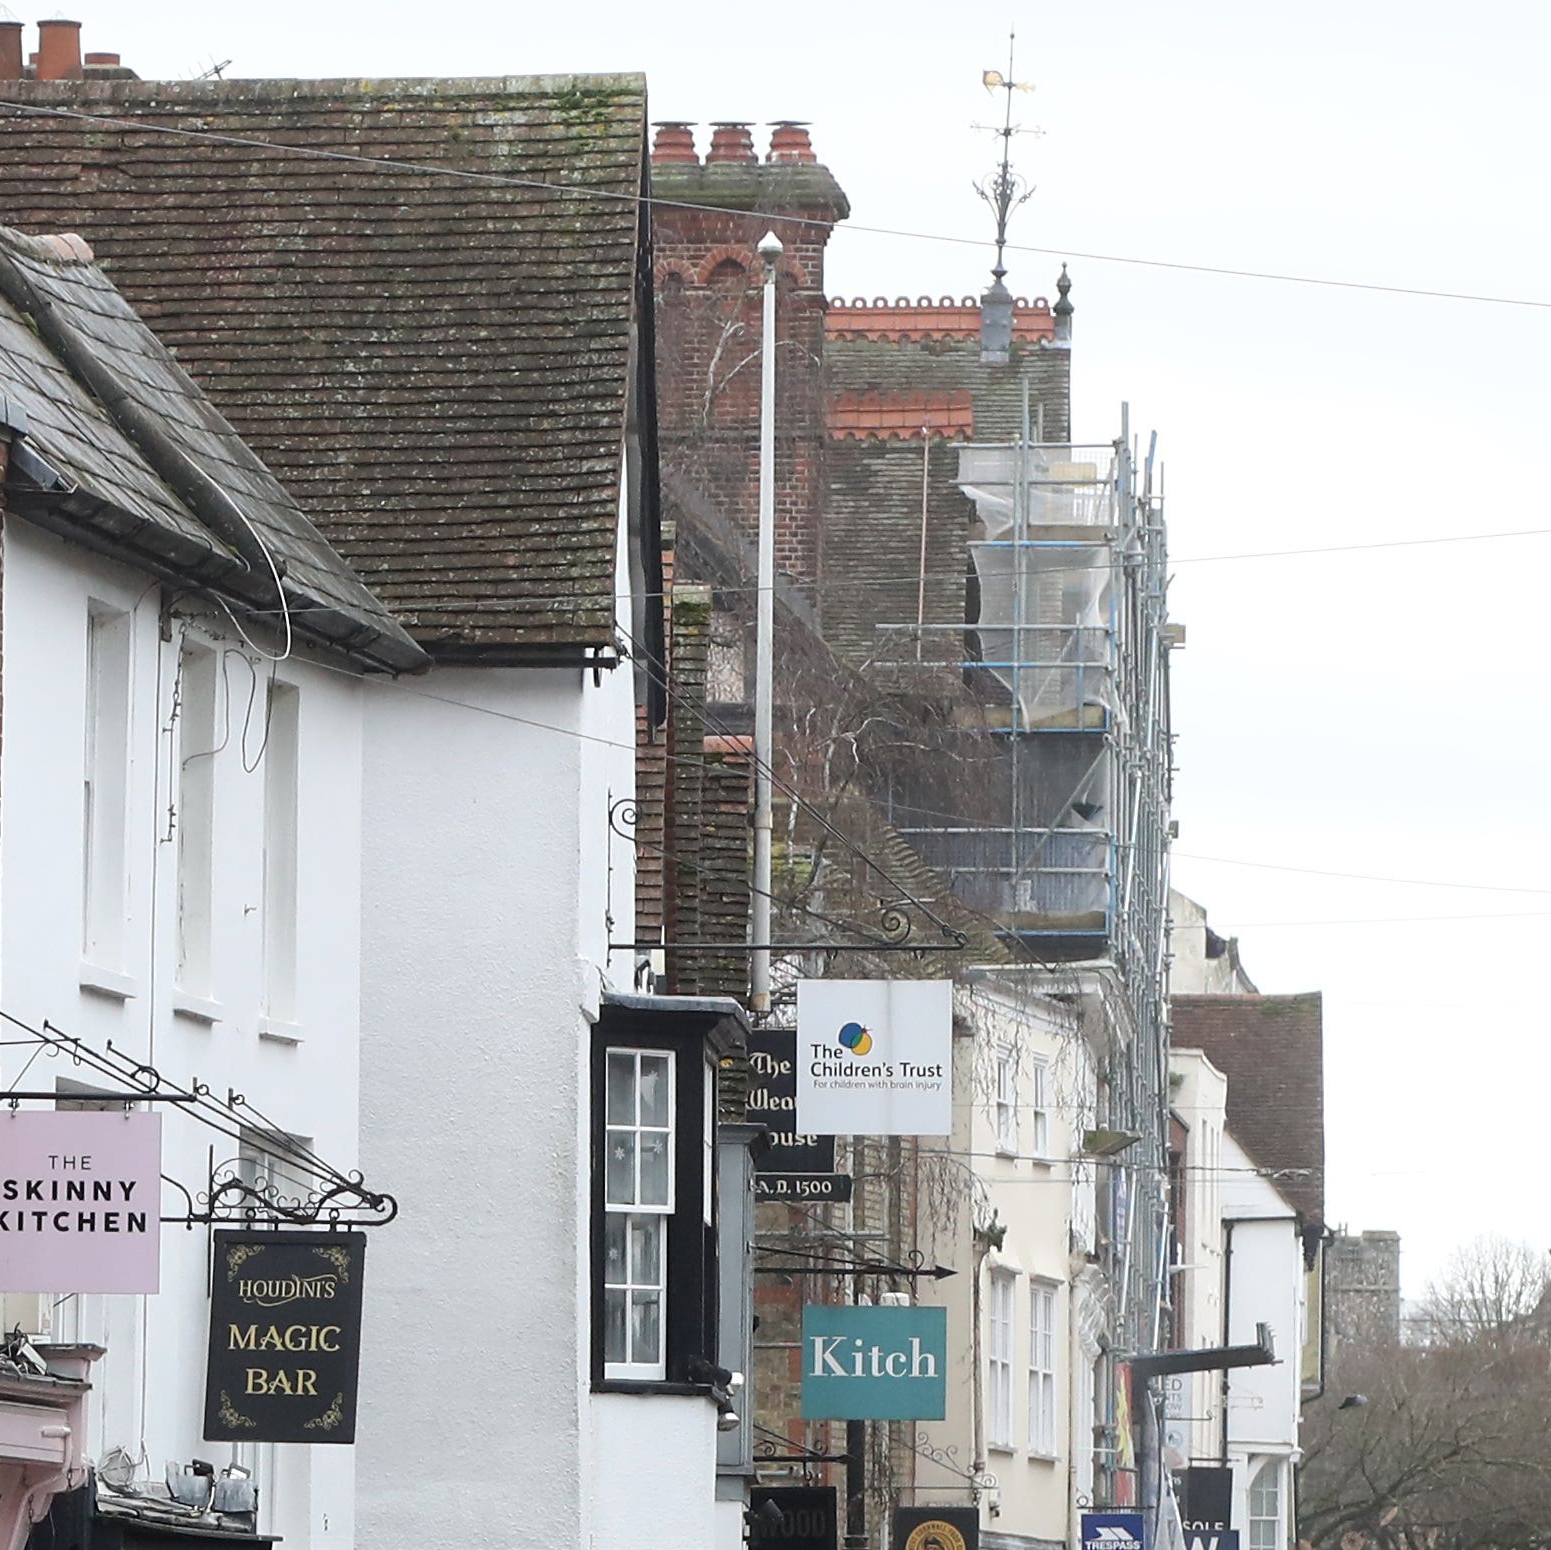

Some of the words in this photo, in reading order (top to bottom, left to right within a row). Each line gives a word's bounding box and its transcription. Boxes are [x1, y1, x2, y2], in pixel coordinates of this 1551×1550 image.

[810, 1043, 843, 1060] The
[749, 1051, 792, 1079] The
[810, 1061, 894, 1079] Children's
[899, 1062, 944, 1079] Trust
[813, 1079, 829, 1090] For
[830, 1079, 867, 1090] children
[867, 1079, 889, 1090] with
[890, 1079, 915, 1091] brain
[769, 1131, 819, 1147] ouse
[48, 1155, 92, 1171] THE
[2, 1179, 138, 1202] SKINNY
[795, 1179, 833, 1196] 1500
[238, 1275, 338, 1306] HOUDINI'S
[228, 1323, 342, 1353] MAGIC
[808, 1335, 939, 1378] Kitch
[244, 1367, 319, 1397] BAR
[1084, 1541, 1142, 1550] TRESPASS
